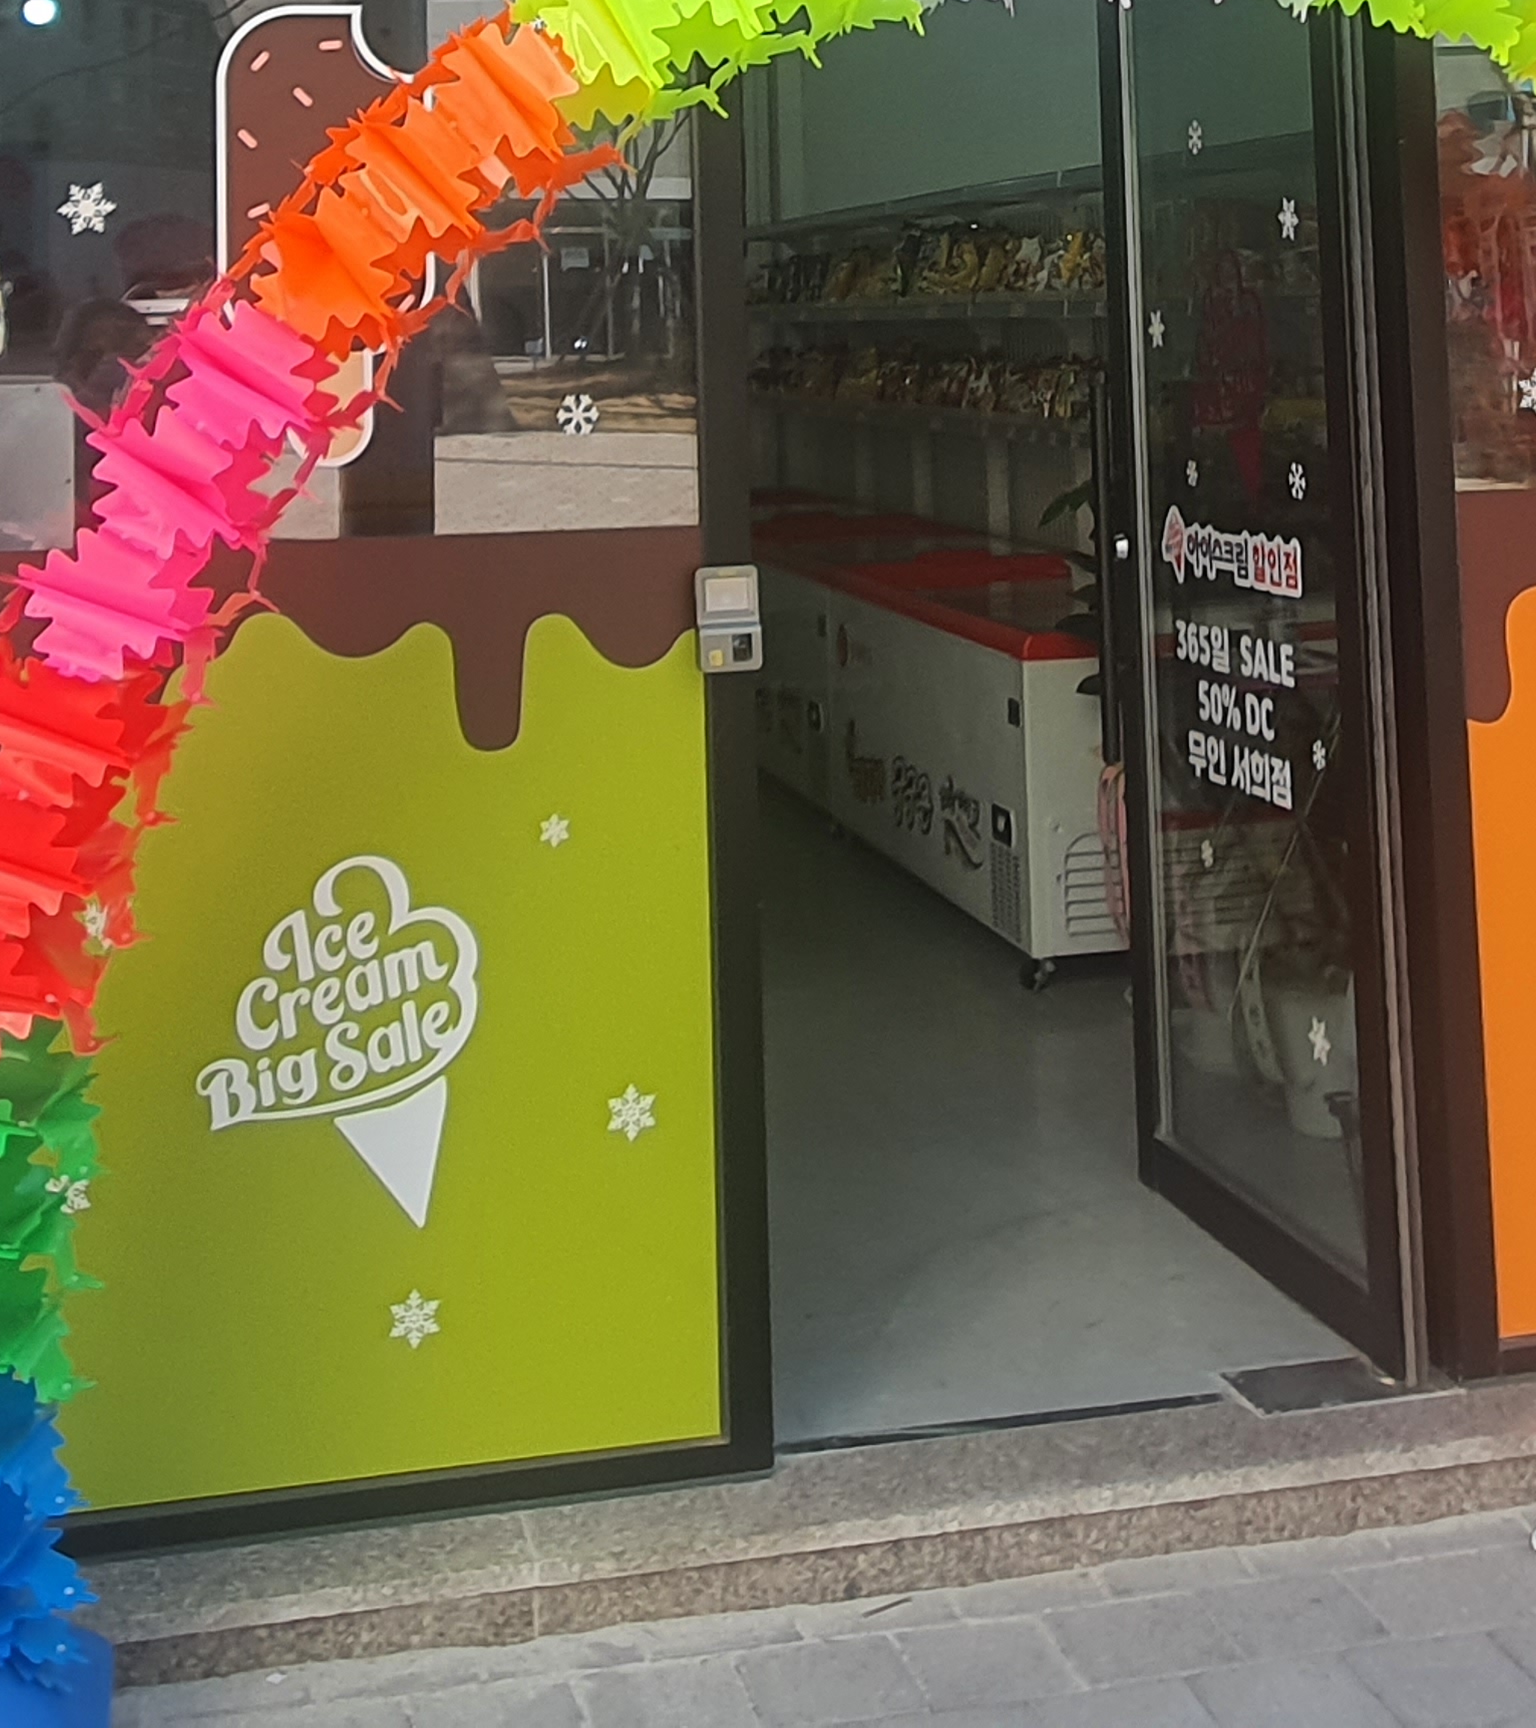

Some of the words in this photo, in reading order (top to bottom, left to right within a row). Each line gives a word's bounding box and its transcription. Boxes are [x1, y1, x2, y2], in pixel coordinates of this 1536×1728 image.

[1175, 619, 1231, 674] 365일
[1239, 635, 1296, 689] SALE
[1198, 679, 1242, 732] 50%
[1244, 692, 1275, 742] DC
[1187, 729, 1227, 786] 무인
[1230, 744, 1293, 811] 서희점
[264, 910, 379, 982] Ice
[236, 940, 450, 1050] Cream
[196, 1048, 318, 1132] Big
[325, 1000, 452, 1092] Sale
